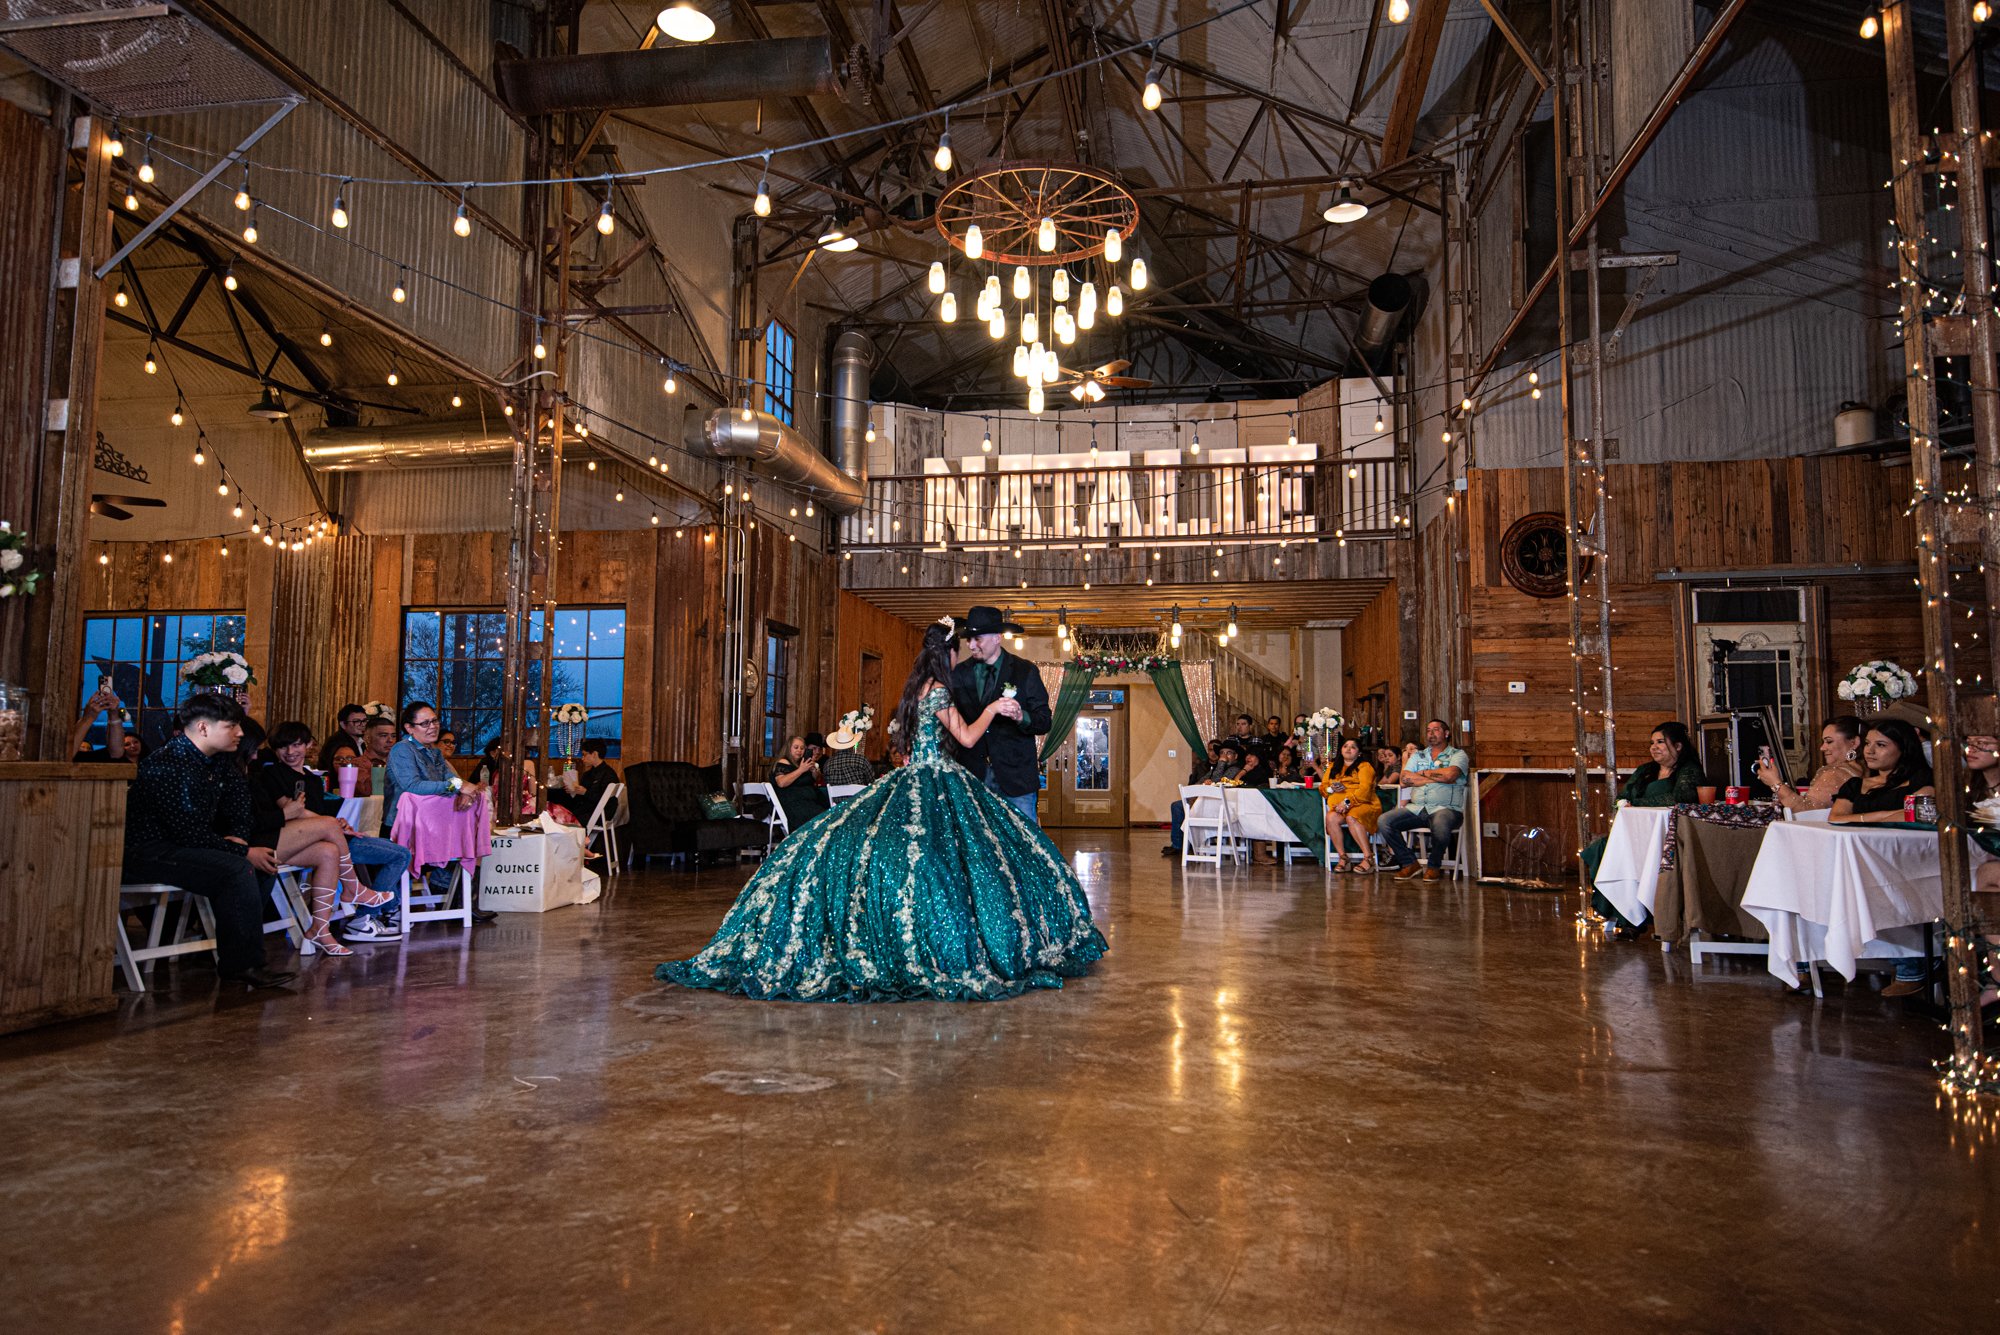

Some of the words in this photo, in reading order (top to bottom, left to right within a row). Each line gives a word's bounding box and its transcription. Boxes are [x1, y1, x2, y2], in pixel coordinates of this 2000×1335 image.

[922, 443, 1319, 552] NATALIE
[495, 864, 540, 874] QUINCE
[484, 885, 534, 895] NATALIE
